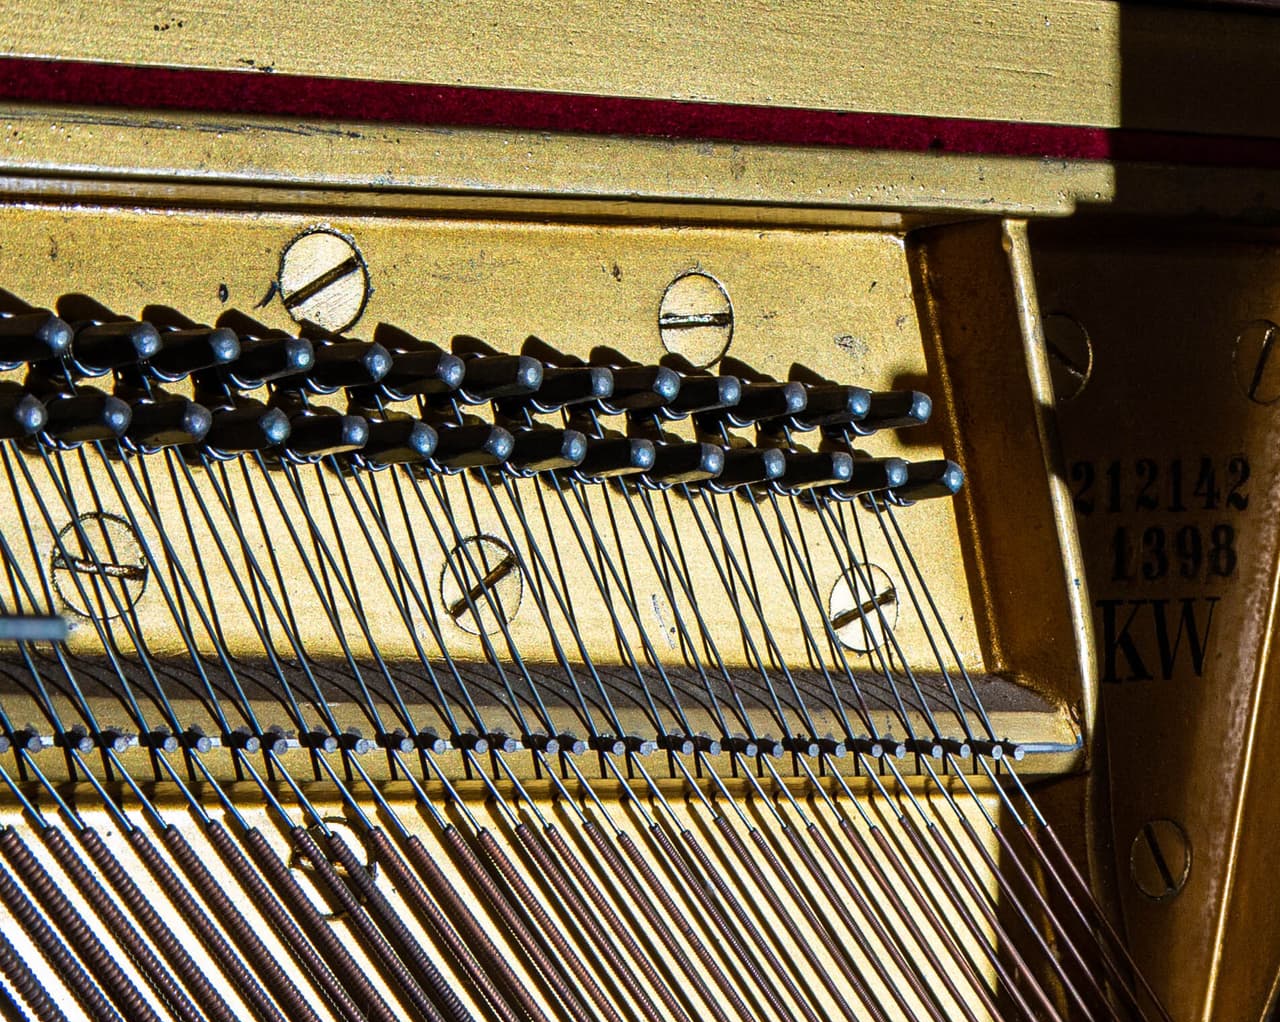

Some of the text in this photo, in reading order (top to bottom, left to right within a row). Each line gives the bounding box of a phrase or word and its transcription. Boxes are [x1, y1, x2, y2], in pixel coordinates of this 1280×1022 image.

[1072, 457, 1250, 515] 212142
[1110, 524, 1237, 582] 1398
[1095, 596, 1222, 685] KW
